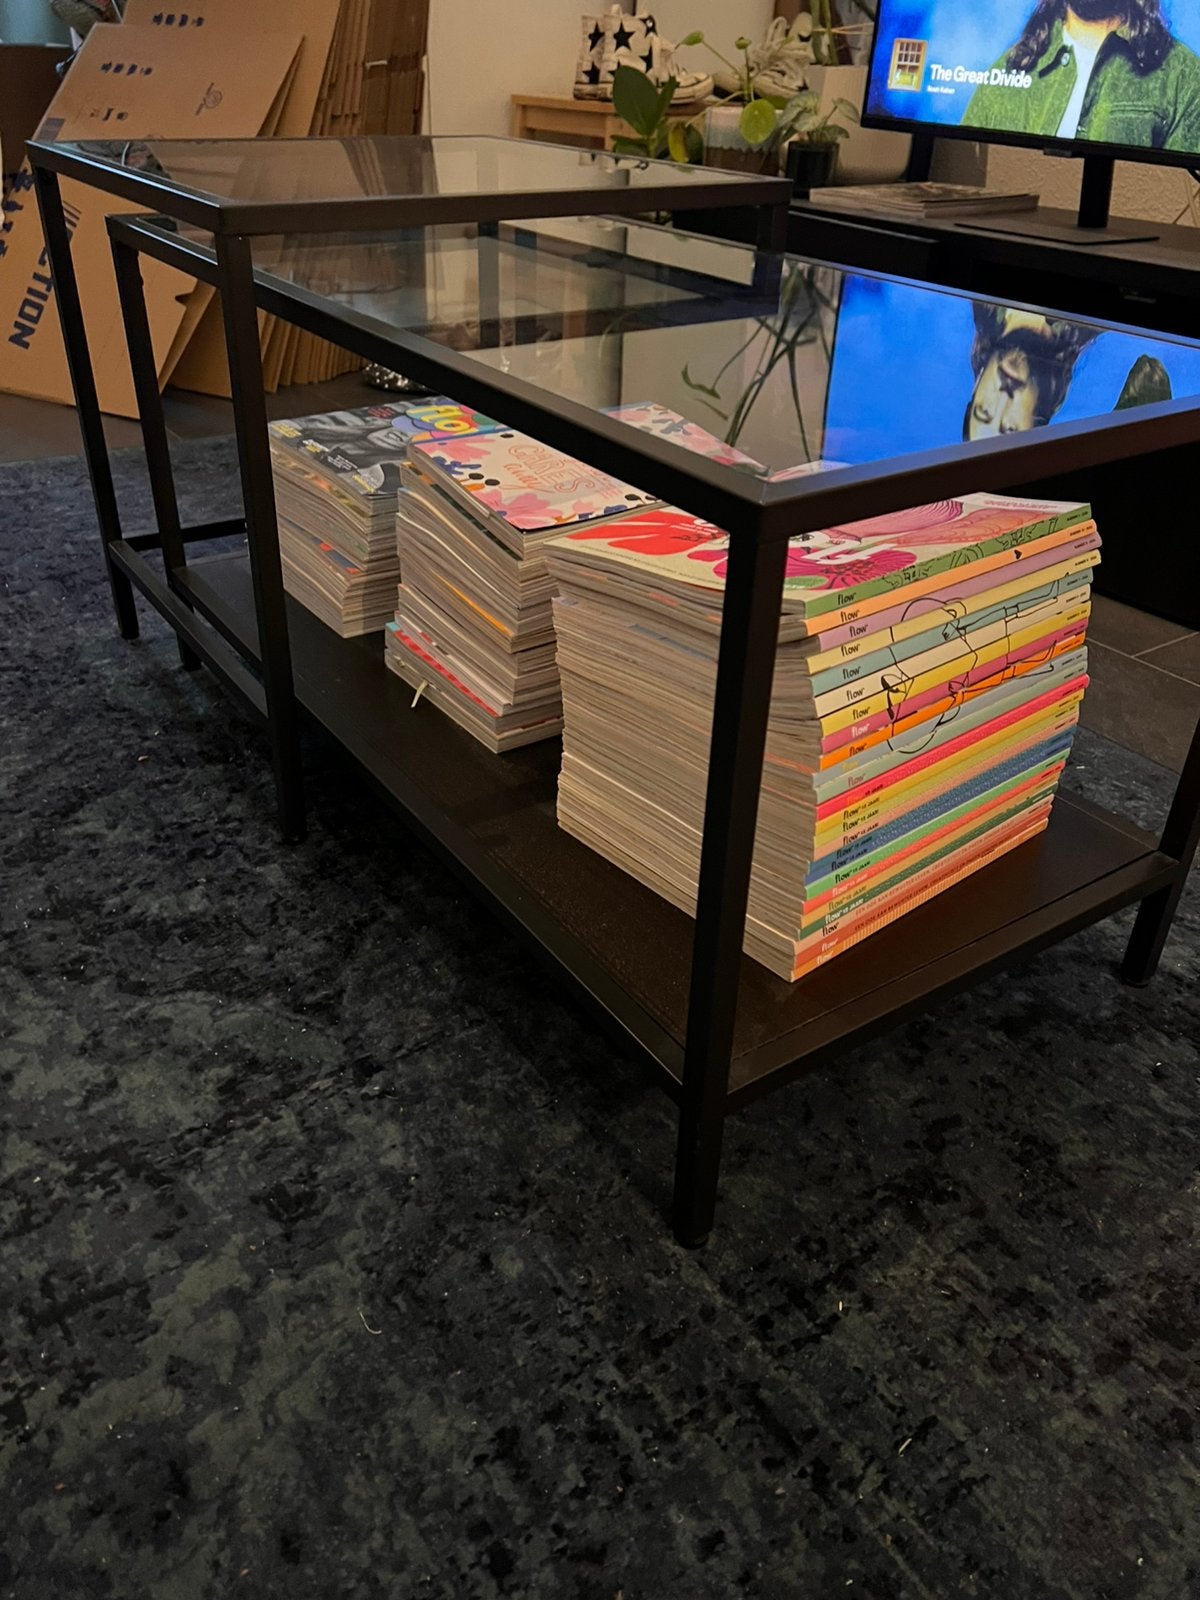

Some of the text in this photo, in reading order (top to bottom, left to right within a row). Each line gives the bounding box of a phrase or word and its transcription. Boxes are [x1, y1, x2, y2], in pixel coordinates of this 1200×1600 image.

[931, 64, 1032, 89] The Great Divide
[837, 592, 857, 605] flow
[840, 609, 860, 622] flow
[849, 624, 868, 638] flow
[841, 644, 860, 657] flow
[842, 666, 861, 680] flow
[846, 687, 865, 701] flow
[852, 706, 871, 721] flow
[851, 723, 870, 738] flow
[849, 742, 867, 757] flow
[843, 806, 861, 820] flow
[842, 818, 860, 832] flow
[843, 832, 861, 846] flow
[835, 870, 853, 884] flow
[825, 909, 842, 924] flow
[822, 922, 840, 936] flow
